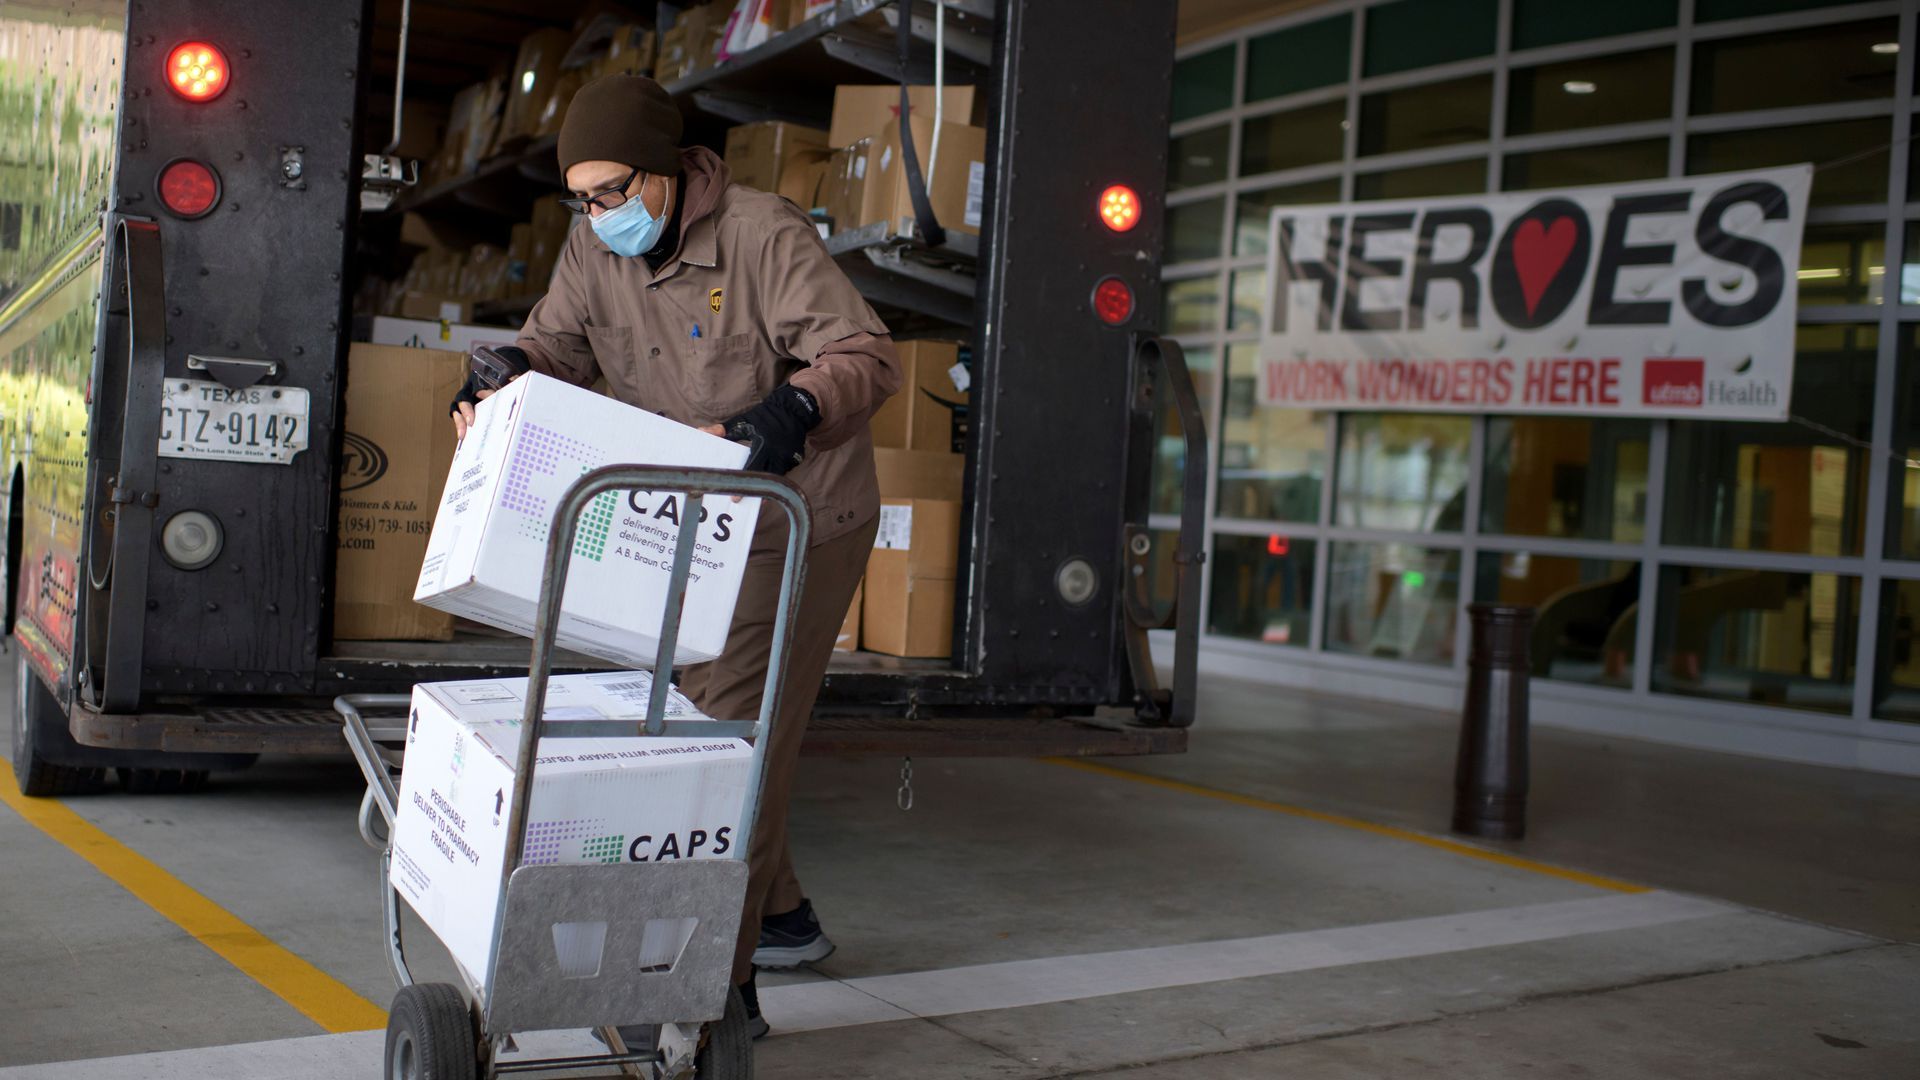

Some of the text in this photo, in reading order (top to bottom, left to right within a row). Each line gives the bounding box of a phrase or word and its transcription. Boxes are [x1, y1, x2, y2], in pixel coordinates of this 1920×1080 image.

[1271, 181, 1790, 335] HEROES
[1266, 357, 1621, 405] WORK WONDERS HERE
[1707, 380, 1778, 406] Health
[201, 387, 261, 405] TEXAS
[382, 500, 391, 511] &
[393, 501, 418, 512] Kids
[345, 514, 376, 536] (954)
[406, 520, 431, 535] 1053
[622, 516, 669, 541] delivering
[619, 529, 666, 554] delivering
[615, 546, 623, 556] A
[624, 548, 632, 560] B.
[634, 551, 658, 567] Braun
[577, 752, 618, 762] SHARP
[619, 749, 651, 760] WITH
[650, 745, 701, 757] OPENING
[702, 743, 736, 753] AVOID
[430, 788, 467, 833] PERISHABLE
[413, 791, 480, 867] DELIVER TO PHARMACY
[430, 830, 456, 864] FRAGILE
[628, 826, 732, 862] CAPS
